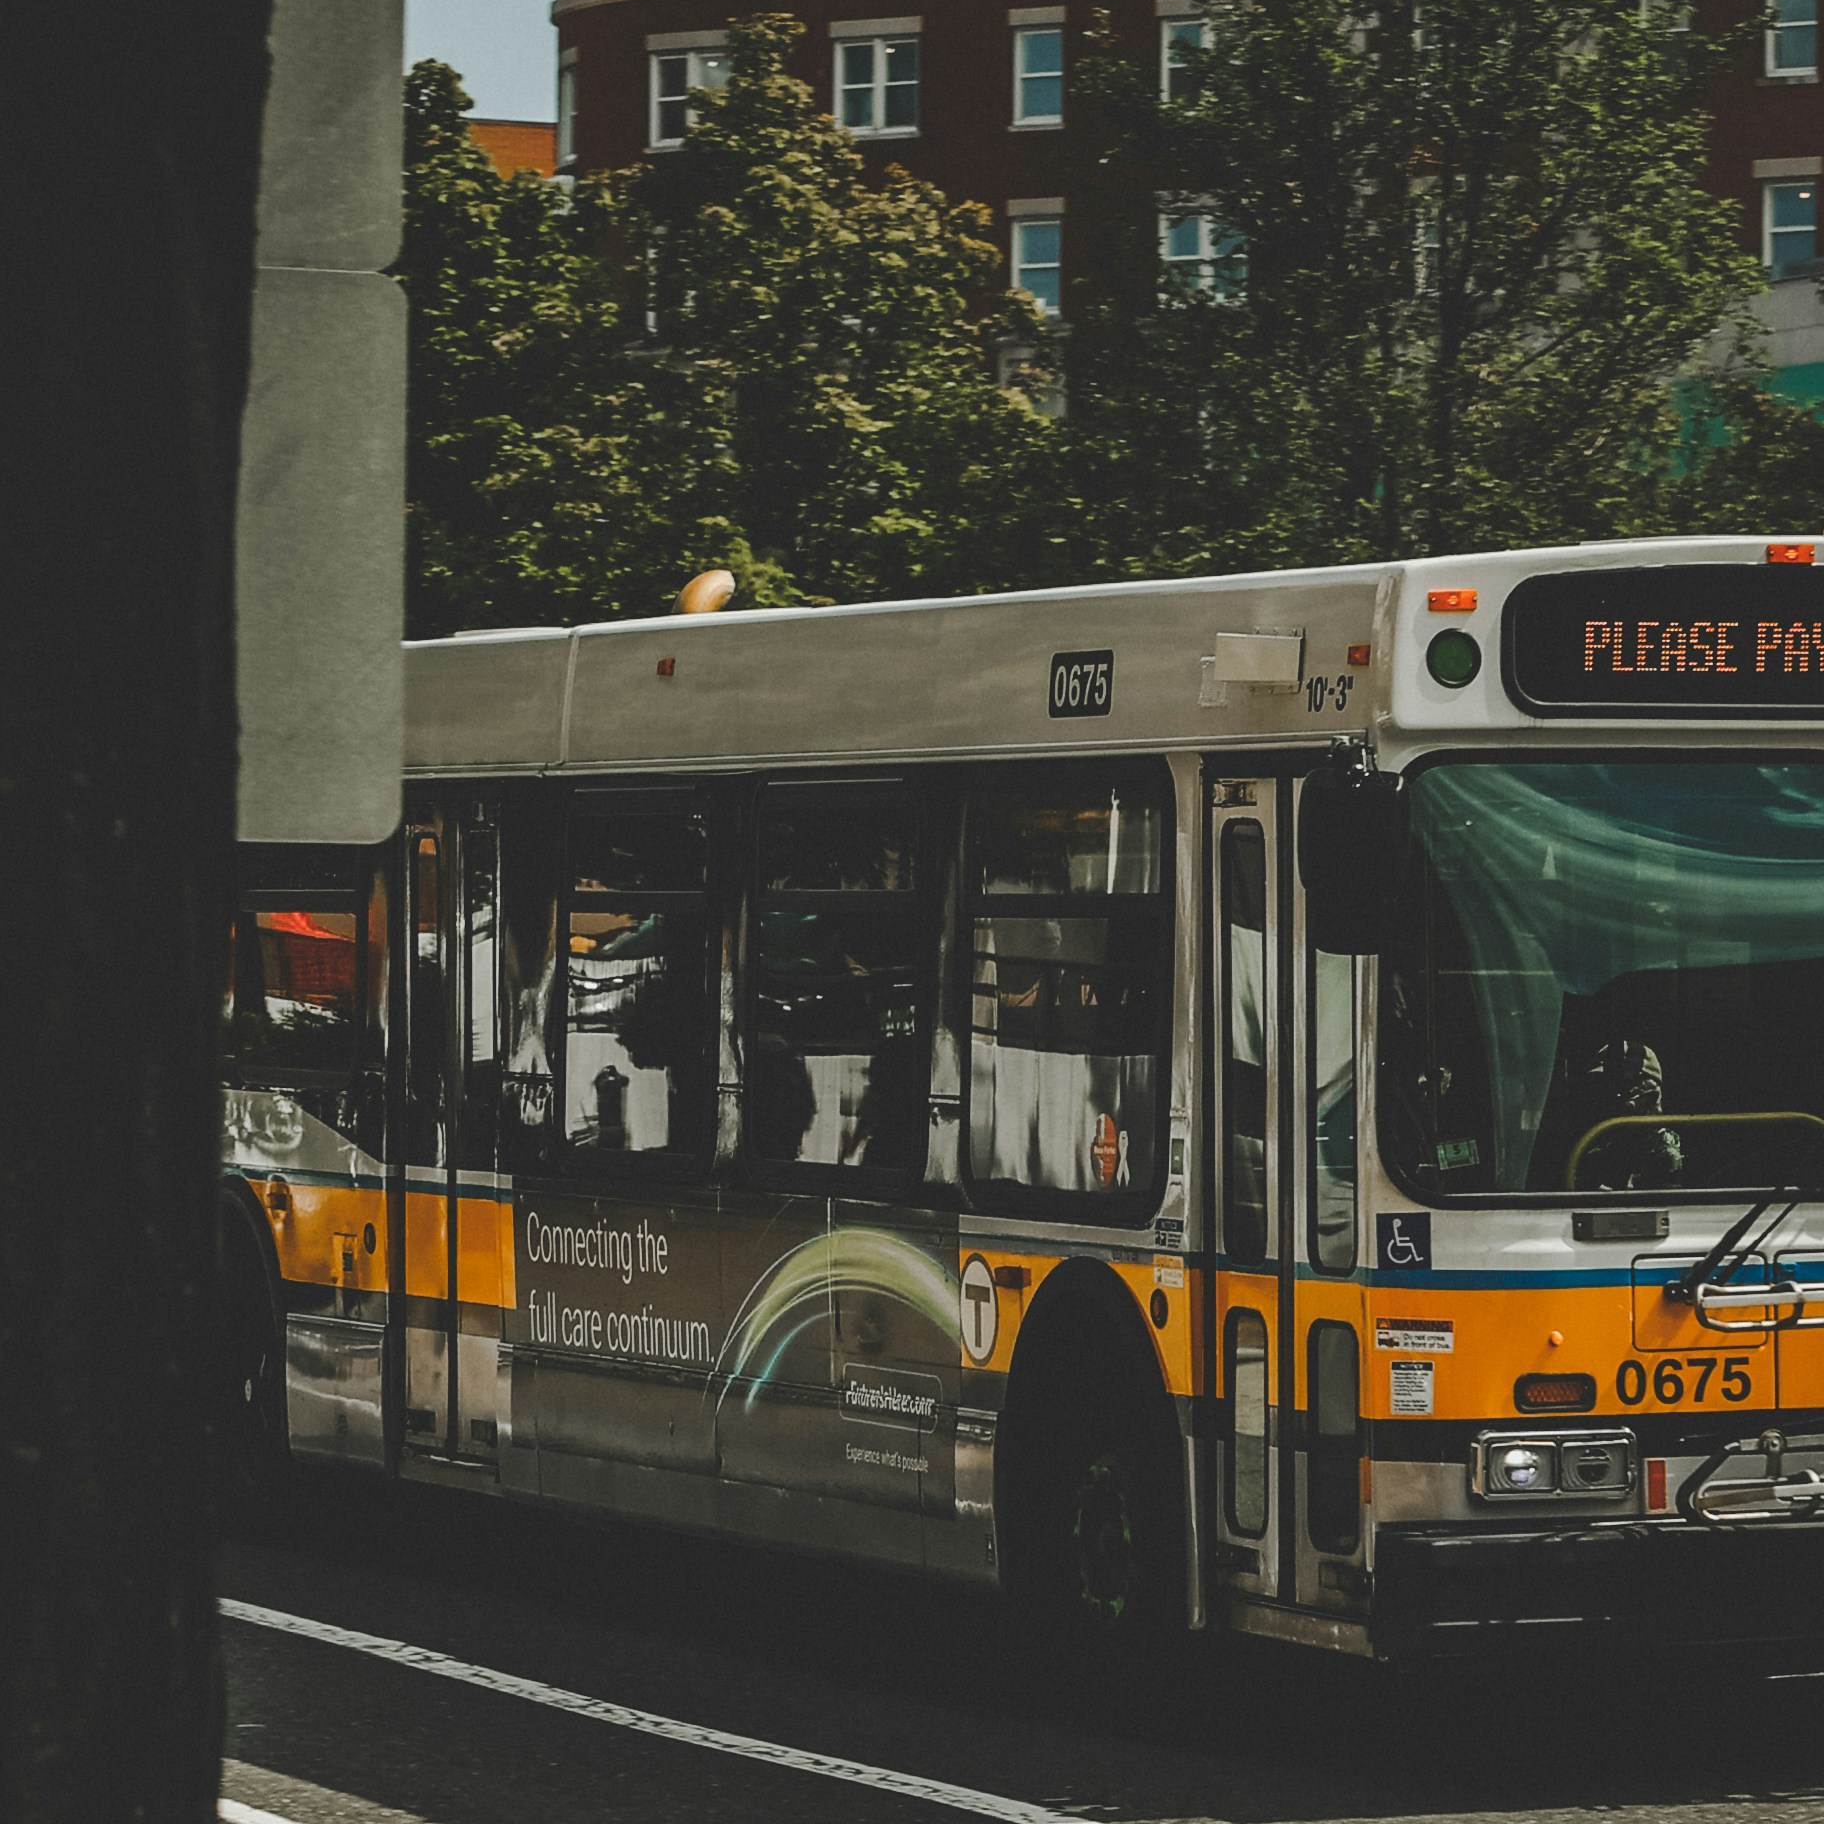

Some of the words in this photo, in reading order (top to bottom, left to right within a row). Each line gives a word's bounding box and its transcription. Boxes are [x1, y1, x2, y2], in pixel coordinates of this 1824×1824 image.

[1584, 620, 1739, 673] PLEASE
[1053, 663, 1109, 708] 0675
[526, 1211, 633, 1285] Connecting
[636, 1218, 669, 1275] the
[528, 1288, 557, 1344] full
[561, 1306, 602, 1350] care
[606, 1303, 716, 1364] continuum.
[964, 1283, 991, 1349] T
[1615, 1356, 1752, 1406] 0675
[845, 1442, 880, 1465] Experience
[880, 1449, 902, 1468] what's
